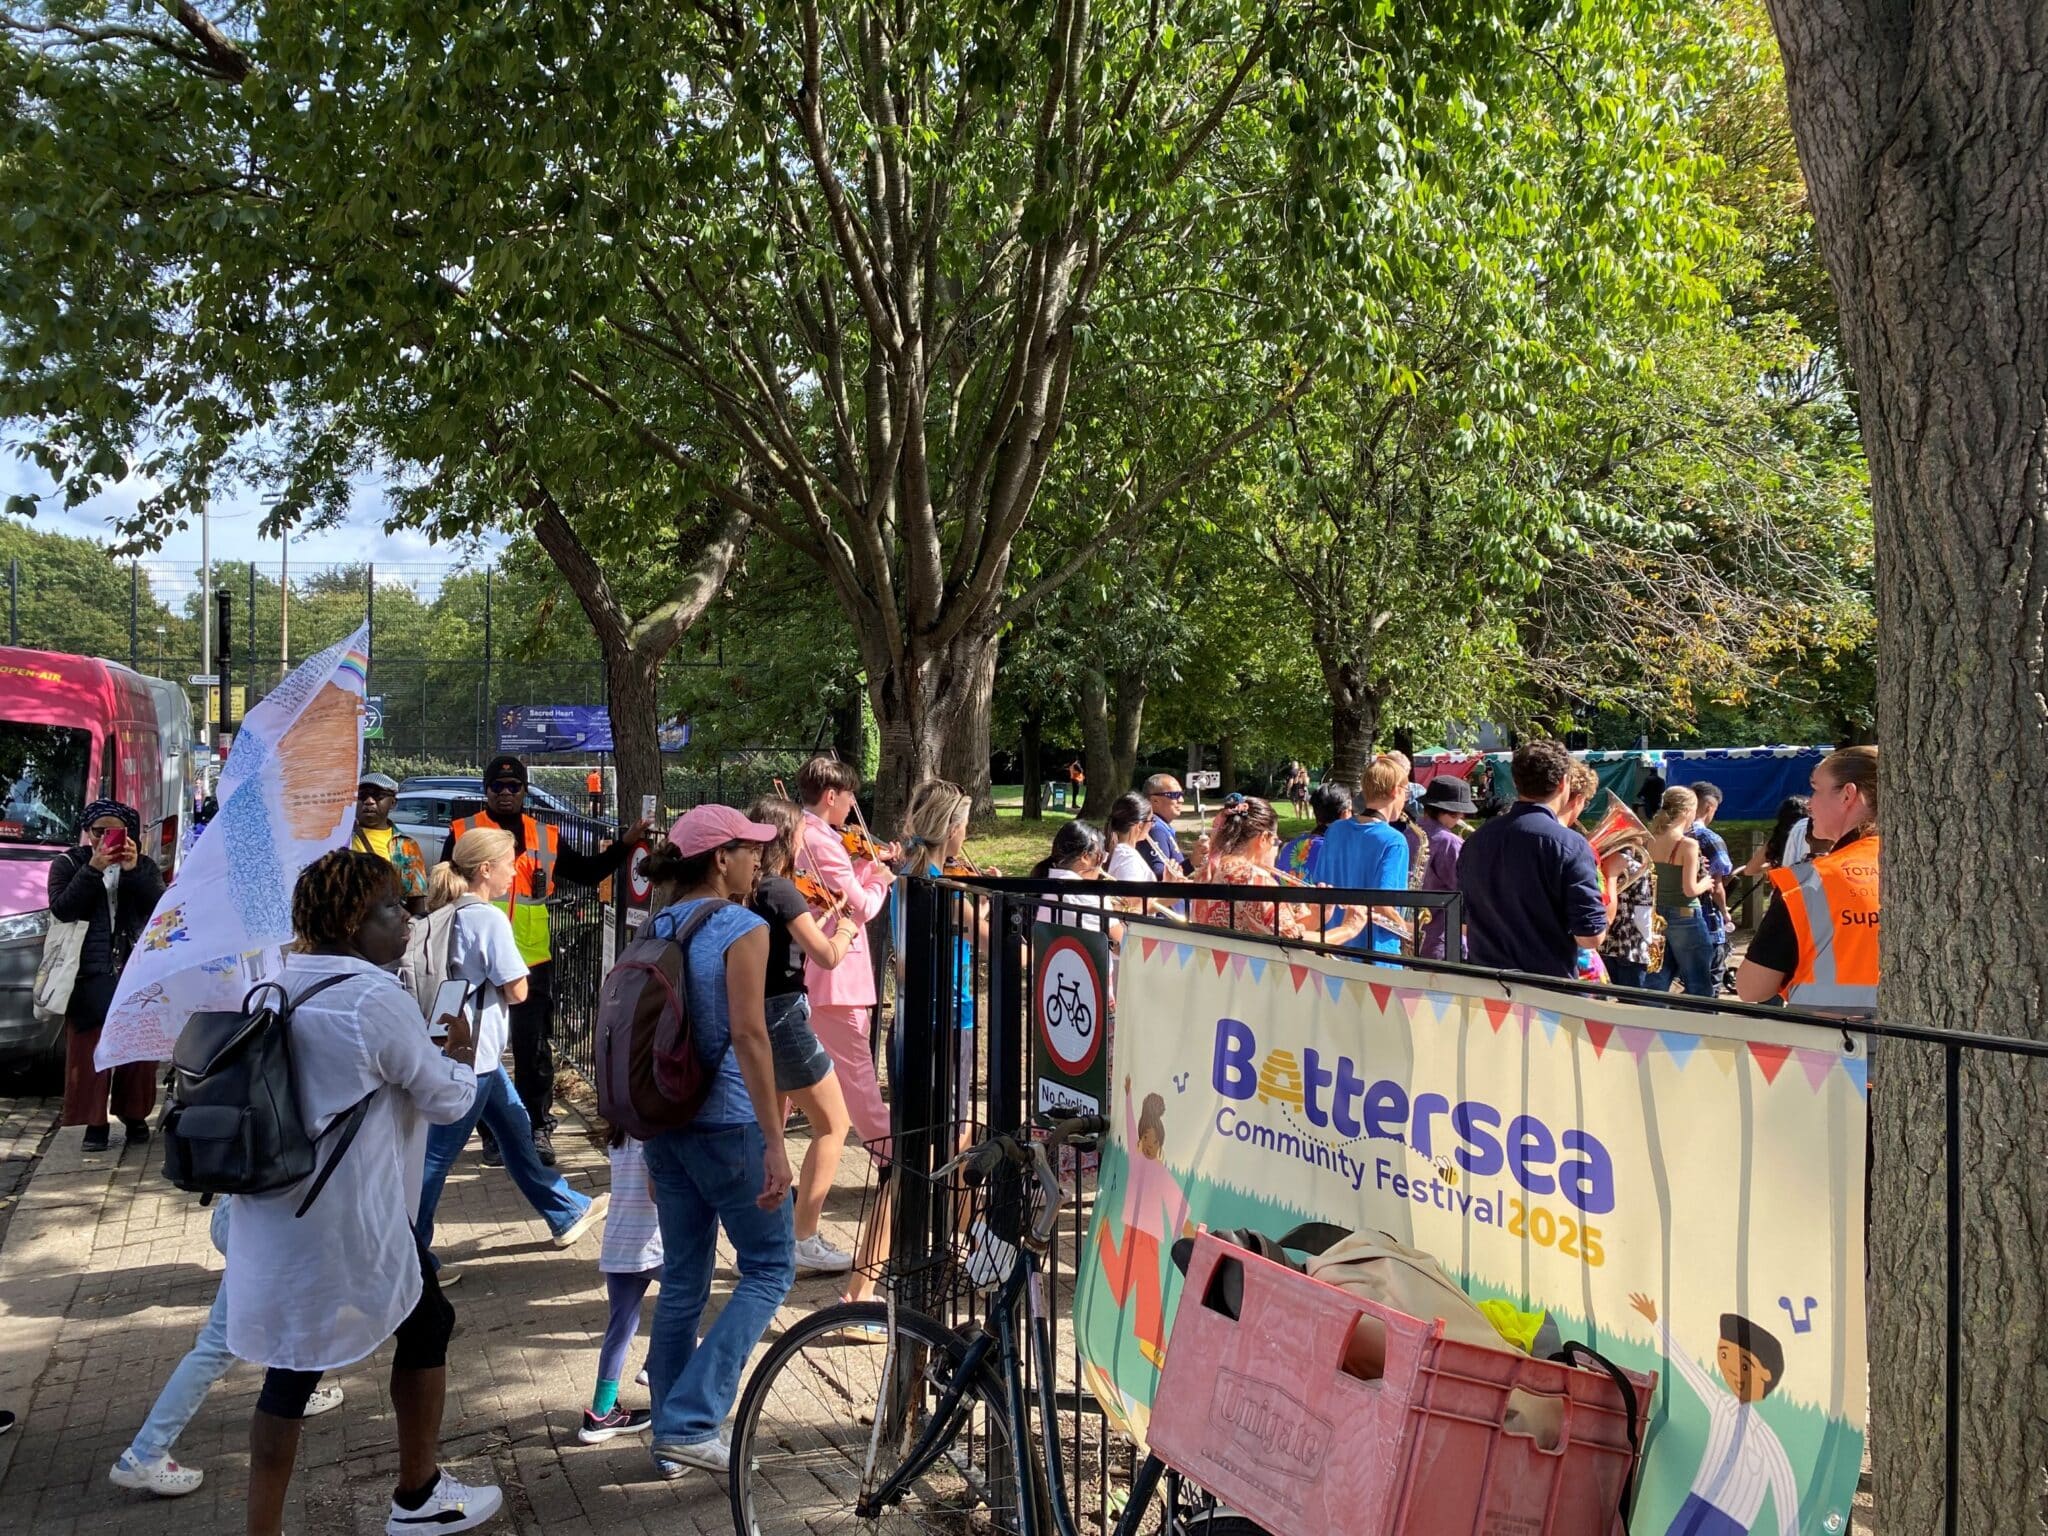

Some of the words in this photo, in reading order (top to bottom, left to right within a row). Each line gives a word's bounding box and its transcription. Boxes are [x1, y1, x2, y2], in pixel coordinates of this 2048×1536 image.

[529, 709, 554, 717] Sacred
[1841, 909, 1879, 928] Sup
[1042, 1084, 1055, 1104] No
[1212, 1018, 1616, 1216] Battersea
[1215, 1106, 1366, 1191] Community
[1375, 1157, 1504, 1229] Festival
[1508, 1197, 1605, 1268] 2025
[1220, 1378, 1320, 1467] Unigate
